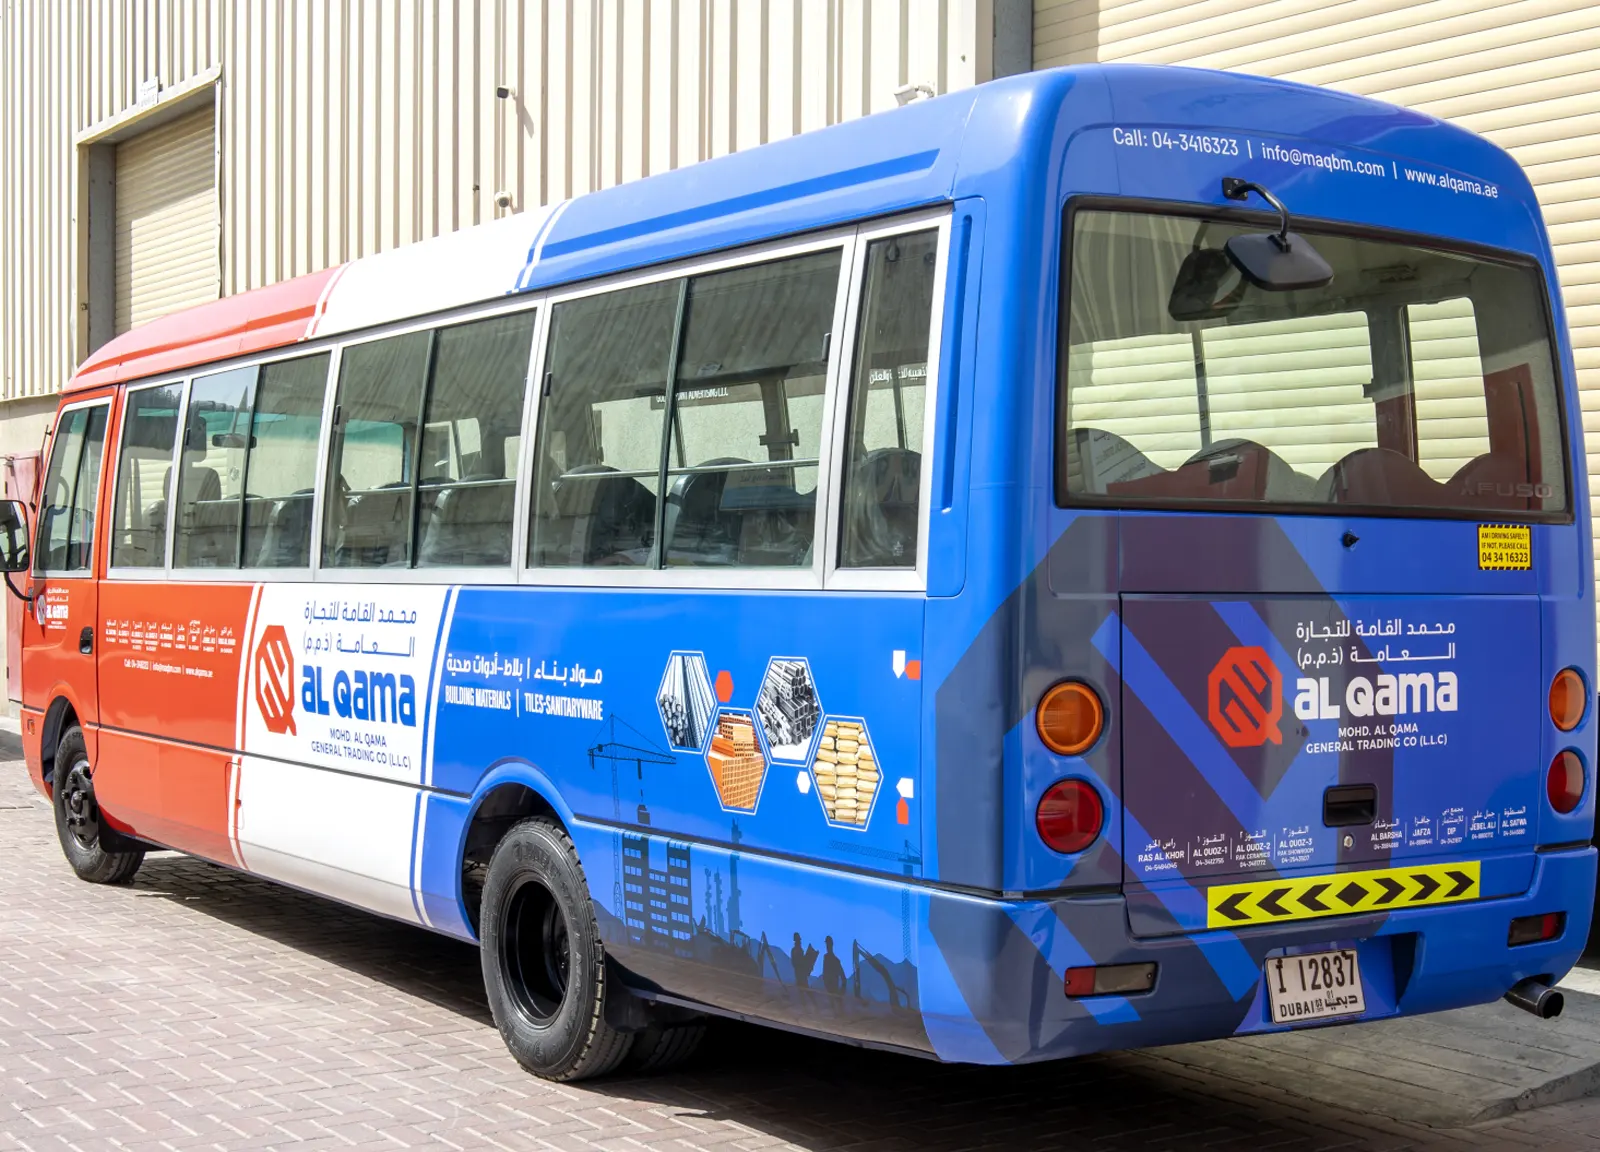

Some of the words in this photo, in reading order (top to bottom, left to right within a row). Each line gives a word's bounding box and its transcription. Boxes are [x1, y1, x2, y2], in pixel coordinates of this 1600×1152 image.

[1113, 127, 1148, 146] Call:
[1152, 131, 1239, 156] 04-3416323
[1261, 142, 1385, 177] info@maqbm.com
[1404, 168, 1498, 199] www.alqama.ae
[1477, 482, 1553, 498] FUSO
[1498, 542, 1516, 550] PLEASE
[1482, 552, 1492, 562] 04
[1493, 552, 1503, 562] 34
[1505, 552, 1529, 563] 16323
[304, 600, 340, 625] للتجارة
[342, 602, 375, 622] القامة
[378, 610, 417, 625] محمد
[1296, 620, 1351, 643] للتجارة
[1355, 618, 1402, 636] القامة
[1406, 622, 1456, 635] محمد
[336, 633, 415, 657] العامة
[1349, 642, 1456, 662] العامة
[446, 653, 471, 677] صحية
[534, 660, 567, 687] بناء
[569, 663, 603, 688] مواد
[445, 685, 475, 706] BUILDING
[475, 688, 511, 710] MATERIALS
[524, 692, 604, 721] TILES-SANITARYWARE
[329, 727, 352, 743] MOHD.
[354, 733, 363, 744] AL
[364, 733, 387, 748] QAMA
[1338, 726, 1372, 738] MOHD.
[1374, 725, 1387, 736] AL
[1389, 723, 1419, 736] QAMA
[1306, 740, 1355, 754] GENERAL
[1357, 737, 1401, 750] TRADING
[1403, 736, 1417, 747] CO
[1419, 734, 1448, 747] (L.L.C)
[311, 741, 342, 757] GENERAL
[343, 746, 375, 763] TRADING
[376, 752, 388, 765] CO
[389, 753, 412, 770] (L.L.C)
[1447, 827, 1457, 835] DIP
[1469, 822, 1487, 831] JEBEL
[1486, 821, 1497, 829] ALI
[1501, 820, 1510, 828] AL
[1509, 818, 1528, 827] SATWA
[1370, 833, 1379, 841] AL
[1379, 830, 1403, 841] BARSHA
[1412, 828, 1431, 837] JAFZA
[1193, 848, 1203, 857] AL
[1203, 846, 1228, 856] QUOZ-1
[1236, 845, 1245, 853] AL
[1246, 842, 1271, 851] QUOZ-2
[1289, 838, 1313, 847] QUOZ-3
[1138, 854, 1153, 863] RAS
[1154, 853, 1164, 861] AL
[1165, 850, 1185, 860] KHOR
[1246, 851, 1271, 860] CERAMICS
[1275, 963, 1287, 993] I
[1298, 953, 1355, 991] 12837
[1279, 1000, 1315, 1018] DUBAI
[1325, 995, 1358, 1010] دبي
